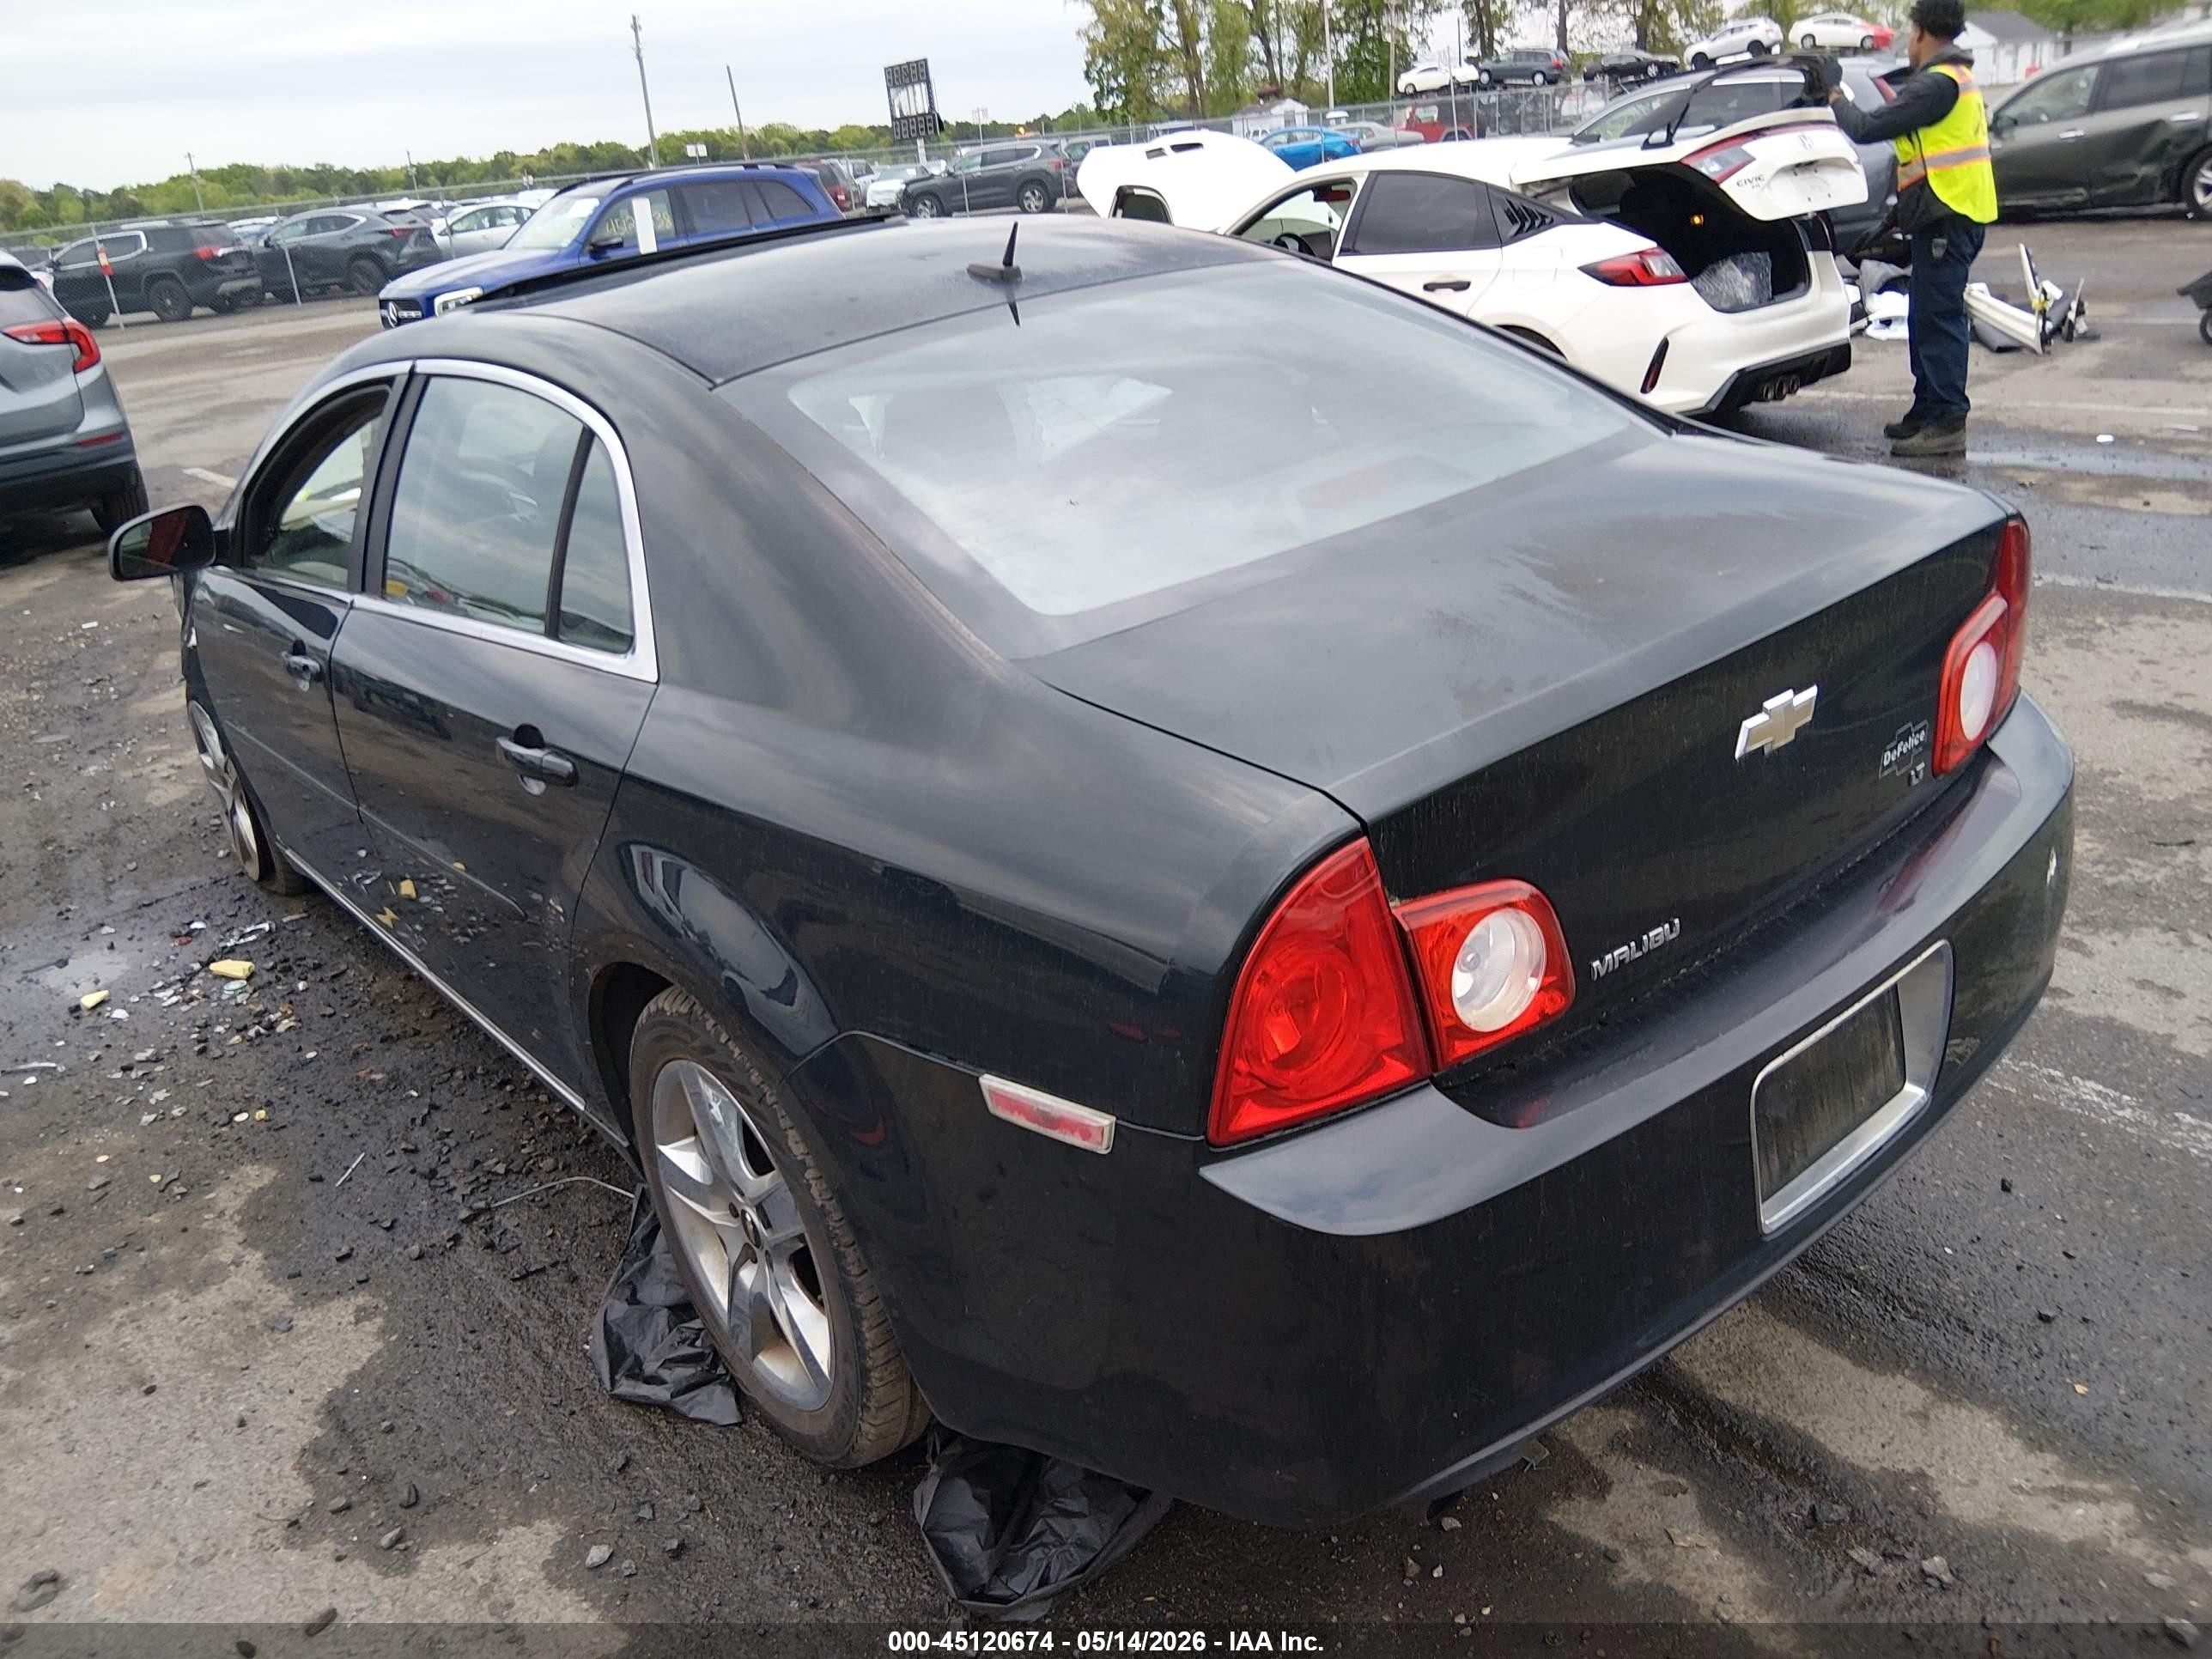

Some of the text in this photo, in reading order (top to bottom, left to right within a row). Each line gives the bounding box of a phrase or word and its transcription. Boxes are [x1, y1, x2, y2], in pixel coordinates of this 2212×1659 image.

[1736, 174, 1765, 187] CIVIC
[1911, 762, 1925, 786] LT
[1590, 917, 1680, 981] MALIBU
